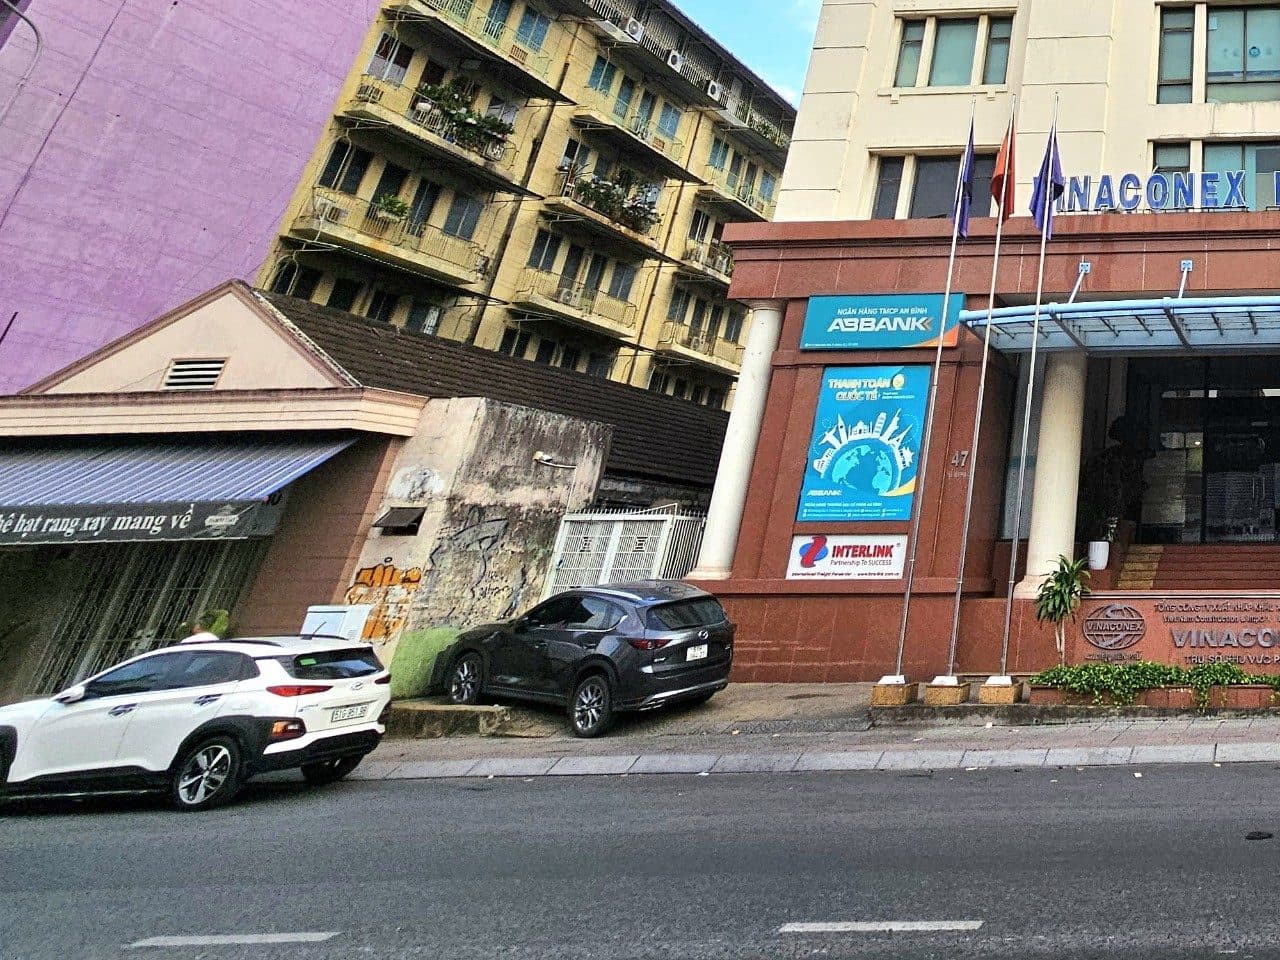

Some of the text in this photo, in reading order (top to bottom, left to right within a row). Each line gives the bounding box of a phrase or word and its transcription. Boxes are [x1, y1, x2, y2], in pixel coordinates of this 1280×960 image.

[1033, 170, 1246, 213] NACONEX
[837, 307, 857, 316] NGÂN
[900, 307, 910, 315] AN
[827, 316, 929, 332] ABBANK
[951, 450, 969, 468] 47
[41, 518, 80, 537] rang
[111, 515, 167, 535] mang
[832, 545, 895, 558] INTERLINK
[830, 559, 860, 567] Partnership
[1086, 622, 1143, 632] VINACONEX
